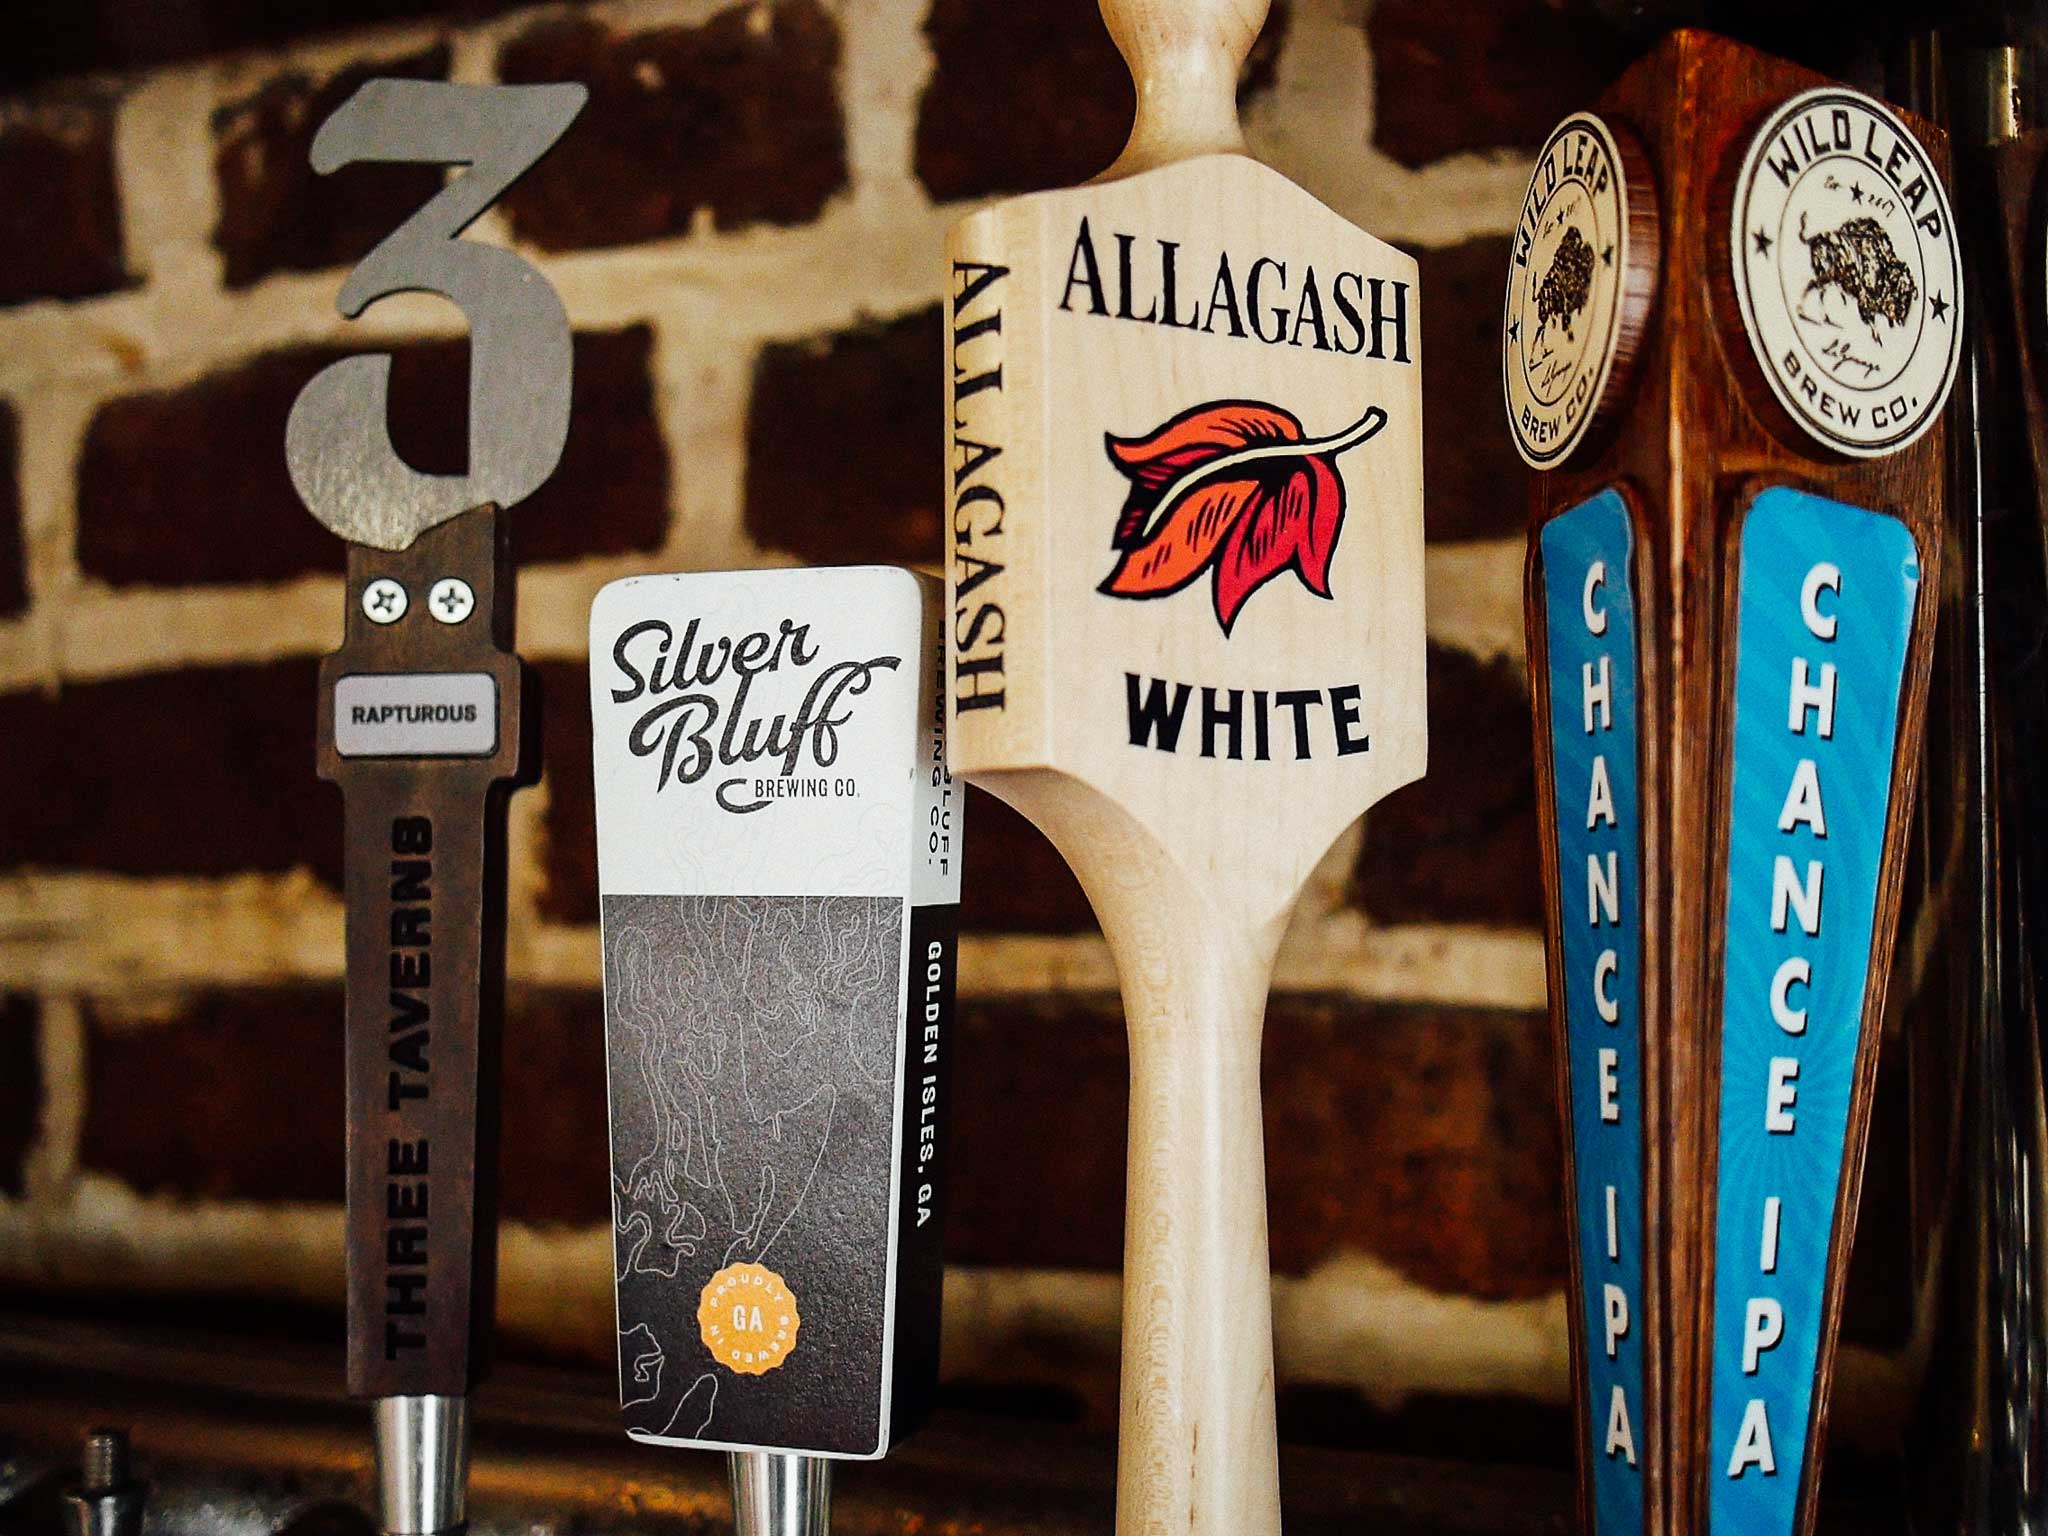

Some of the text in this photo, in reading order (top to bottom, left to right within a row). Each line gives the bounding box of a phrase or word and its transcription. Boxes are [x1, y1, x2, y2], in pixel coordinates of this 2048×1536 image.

[1515, 151, 1556, 268] WILD
[1563, 134, 1608, 199] LEAP
[1767, 109, 1941, 240] WILD LEAP
[286, 78, 589, 552] 3
[1059, 215, 1412, 363] ALLAGASH
[1521, 403, 1560, 443] BREW
[1566, 367, 1593, 424] CO.
[1783, 350, 1918, 430] BREW CO.
[953, 260, 1010, 716] ALLAGASH
[351, 703, 478, 725] RAPTUROUS
[610, 617, 820, 703] Silver
[628, 655, 902, 814] Bluff
[1125, 672, 1370, 761] WHITE
[754, 777, 861, 798] BREWING CO.
[928, 806, 939, 865] CO.
[1583, 560, 1638, 1466] CHANCE IPA
[1727, 561, 1842, 1478] CHANCE IPA
[916, 941, 942, 1228] GOLDEN ISLES, GA
[385, 1137, 430, 1361] THREE
[709, 1272, 785, 1309] PROUDLY
[731, 1315, 790, 1364] BREWED
[732, 1304, 764, 1332] GA
